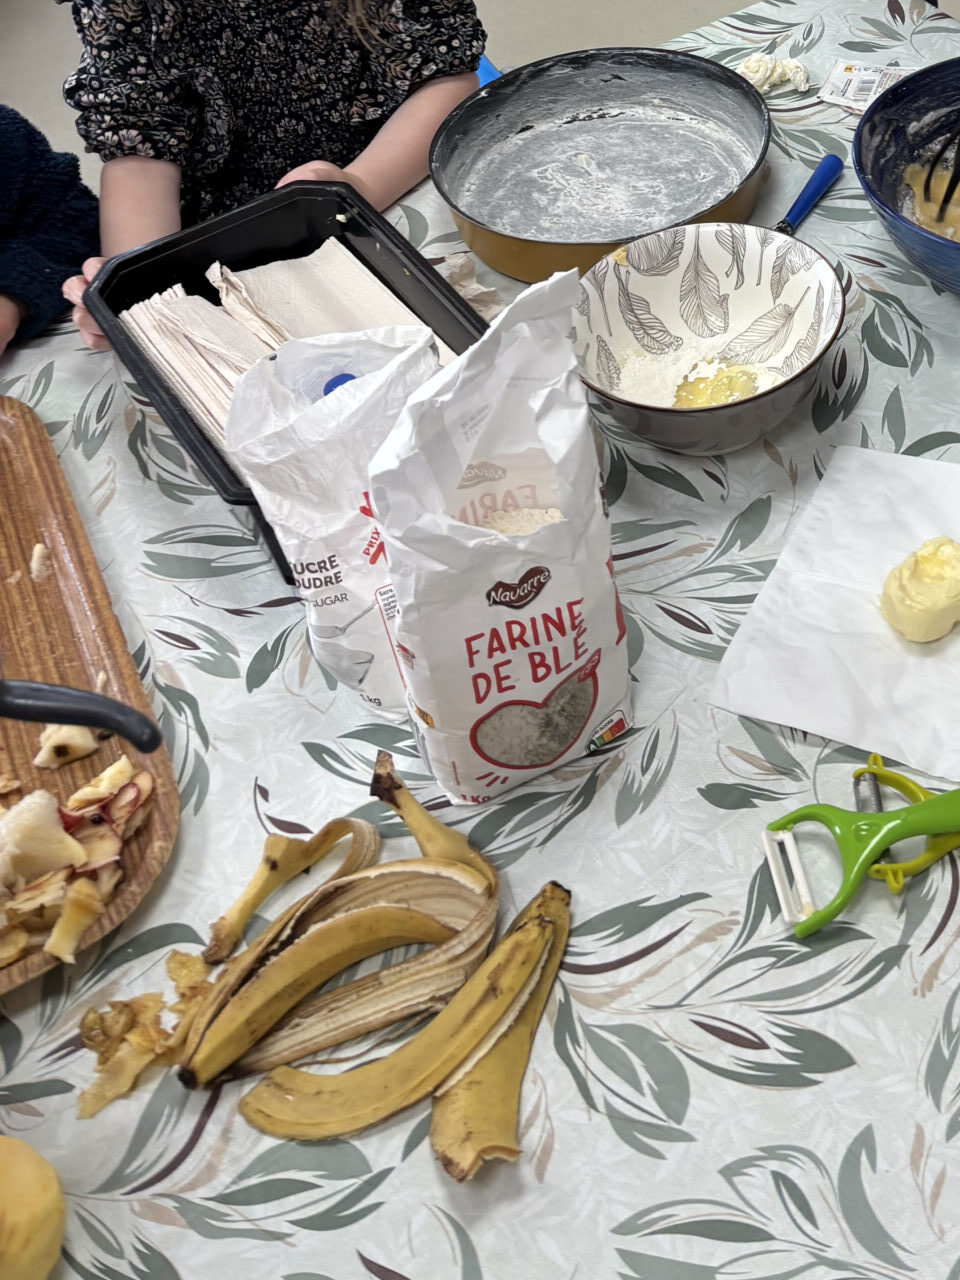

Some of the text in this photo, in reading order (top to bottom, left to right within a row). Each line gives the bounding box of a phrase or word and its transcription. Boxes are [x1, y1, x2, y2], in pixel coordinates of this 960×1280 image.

[362, 527, 381, 556] PRIX
[293, 554, 339, 575] UCRE
[295, 571, 343, 590] UDRE
[488, 570, 551, 607] Navarre
[464, 597, 584, 669] FARINE
[472, 625, 588, 705] DE BLÉ
[367, 695, 382, 707] kg
